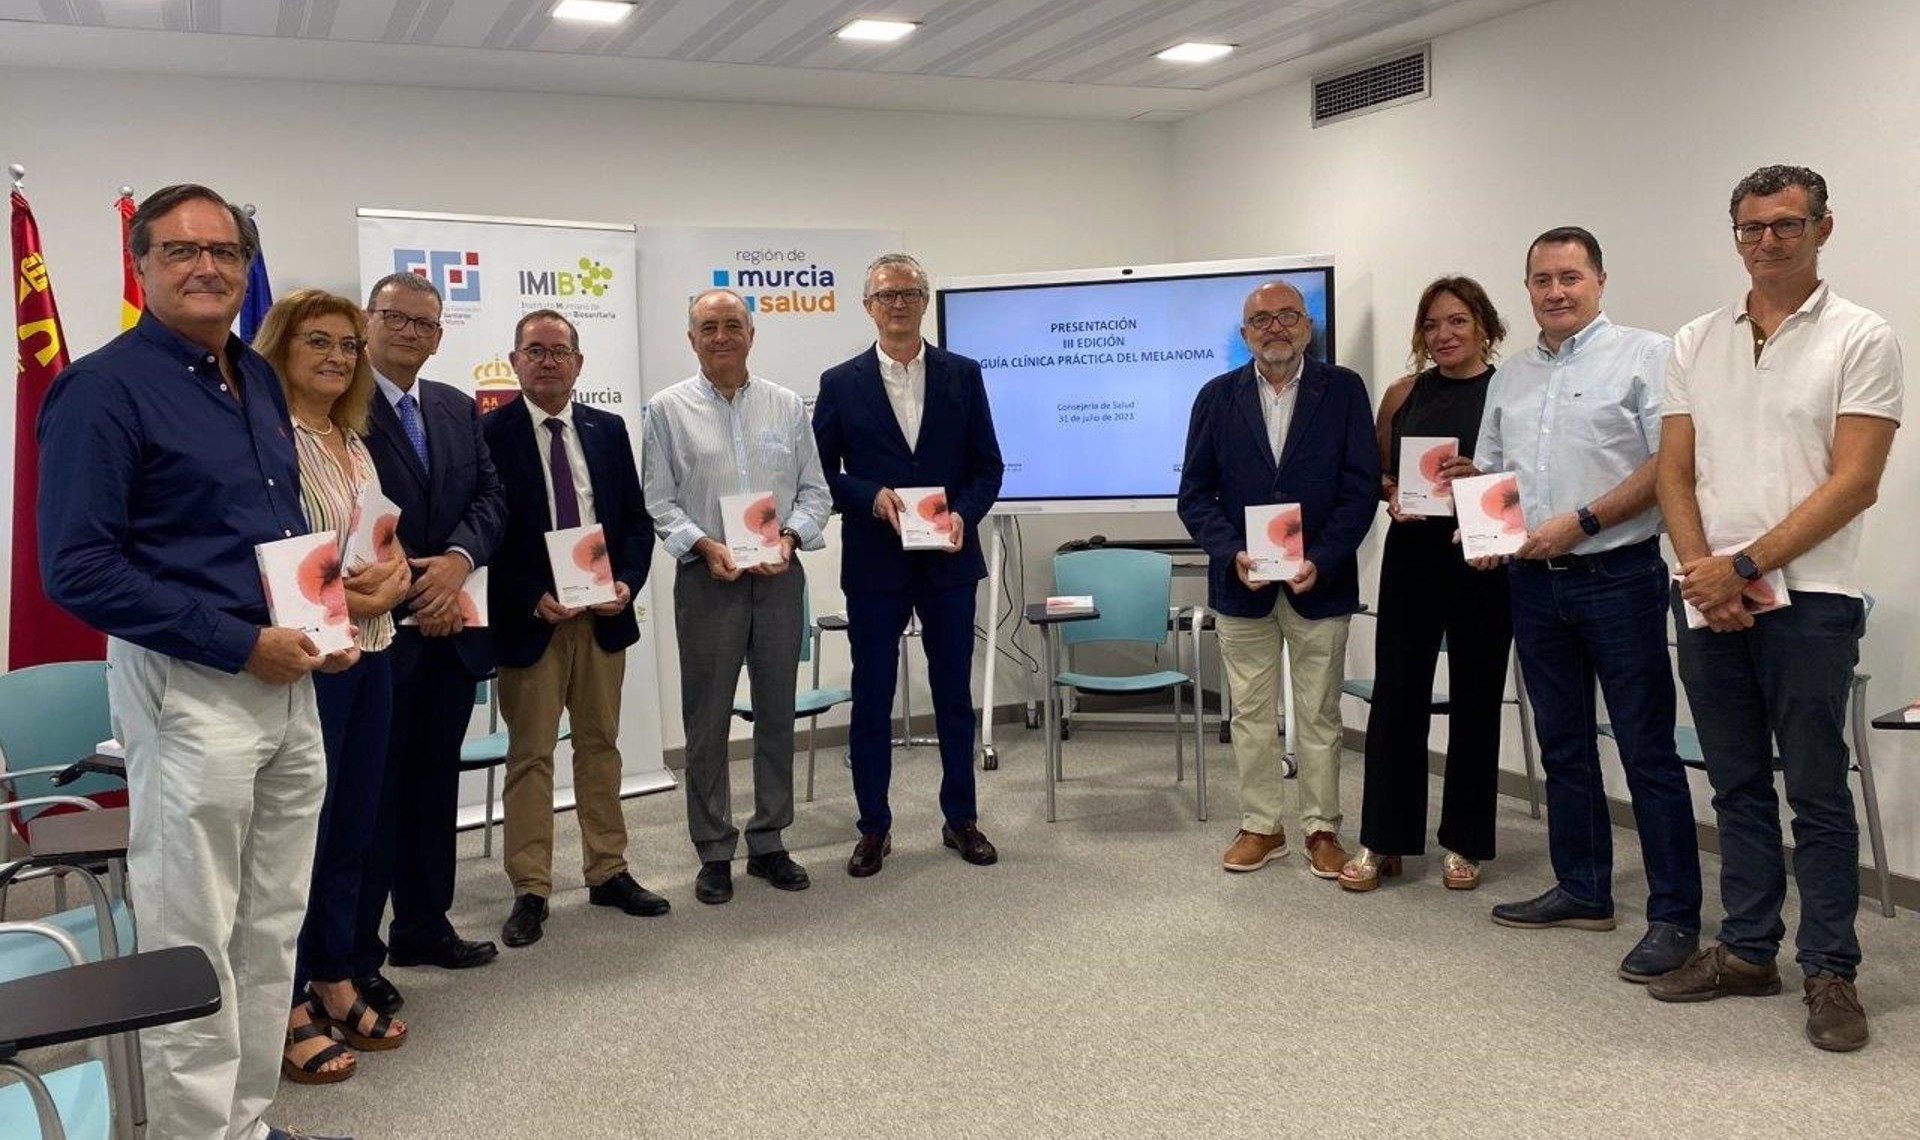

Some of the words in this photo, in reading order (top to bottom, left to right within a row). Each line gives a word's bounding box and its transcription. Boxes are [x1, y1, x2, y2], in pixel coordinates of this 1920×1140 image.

[736, 248, 784, 265] región
[787, 248, 806, 261] de
[519, 270, 575, 296] IMIB
[737, 265, 834, 287] murcia
[760, 290, 835, 312] salud
[1050, 317, 1137, 333] PRESENTACIÓN
[1063, 339, 1074, 349] III
[1077, 336, 1125, 348] EDICIÓN
[980, 356, 1008, 369] GUÍA
[1011, 354, 1054, 368] CLÍNICA
[1058, 352, 1113, 365] PRÁCTICA
[1117, 352, 1137, 362] DEL
[1141, 349, 1214, 362] MELANOMA
[1100, 402, 1110, 410] de
[1112, 401, 1135, 409] Salud
[1059, 415, 1068, 423] 31
[1071, 414, 1080, 422] de
[1082, 413, 1100, 423] julio
[1102, 414, 1112, 422] de
